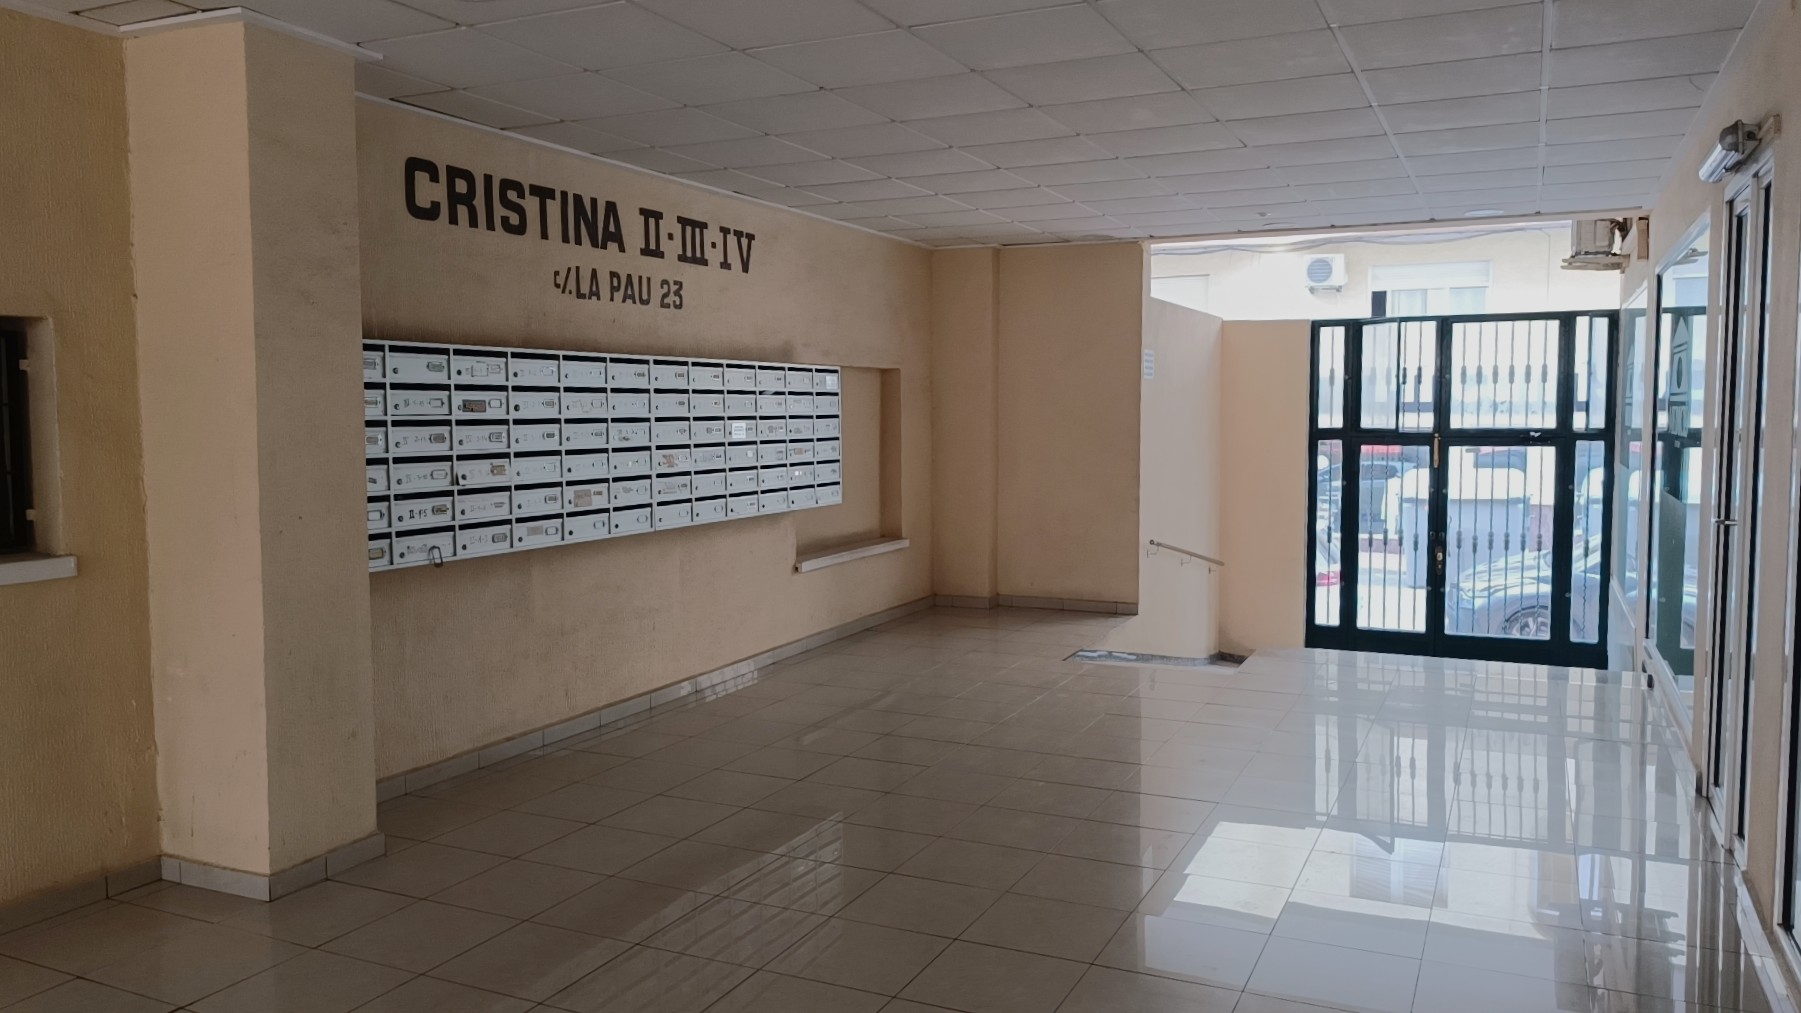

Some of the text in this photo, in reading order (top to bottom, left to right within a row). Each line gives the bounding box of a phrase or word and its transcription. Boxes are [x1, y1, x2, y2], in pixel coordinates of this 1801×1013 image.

[404, 156, 626, 254] CRISTINA
[609, 271, 652, 306] PAU
[659, 279, 684, 310] 23
